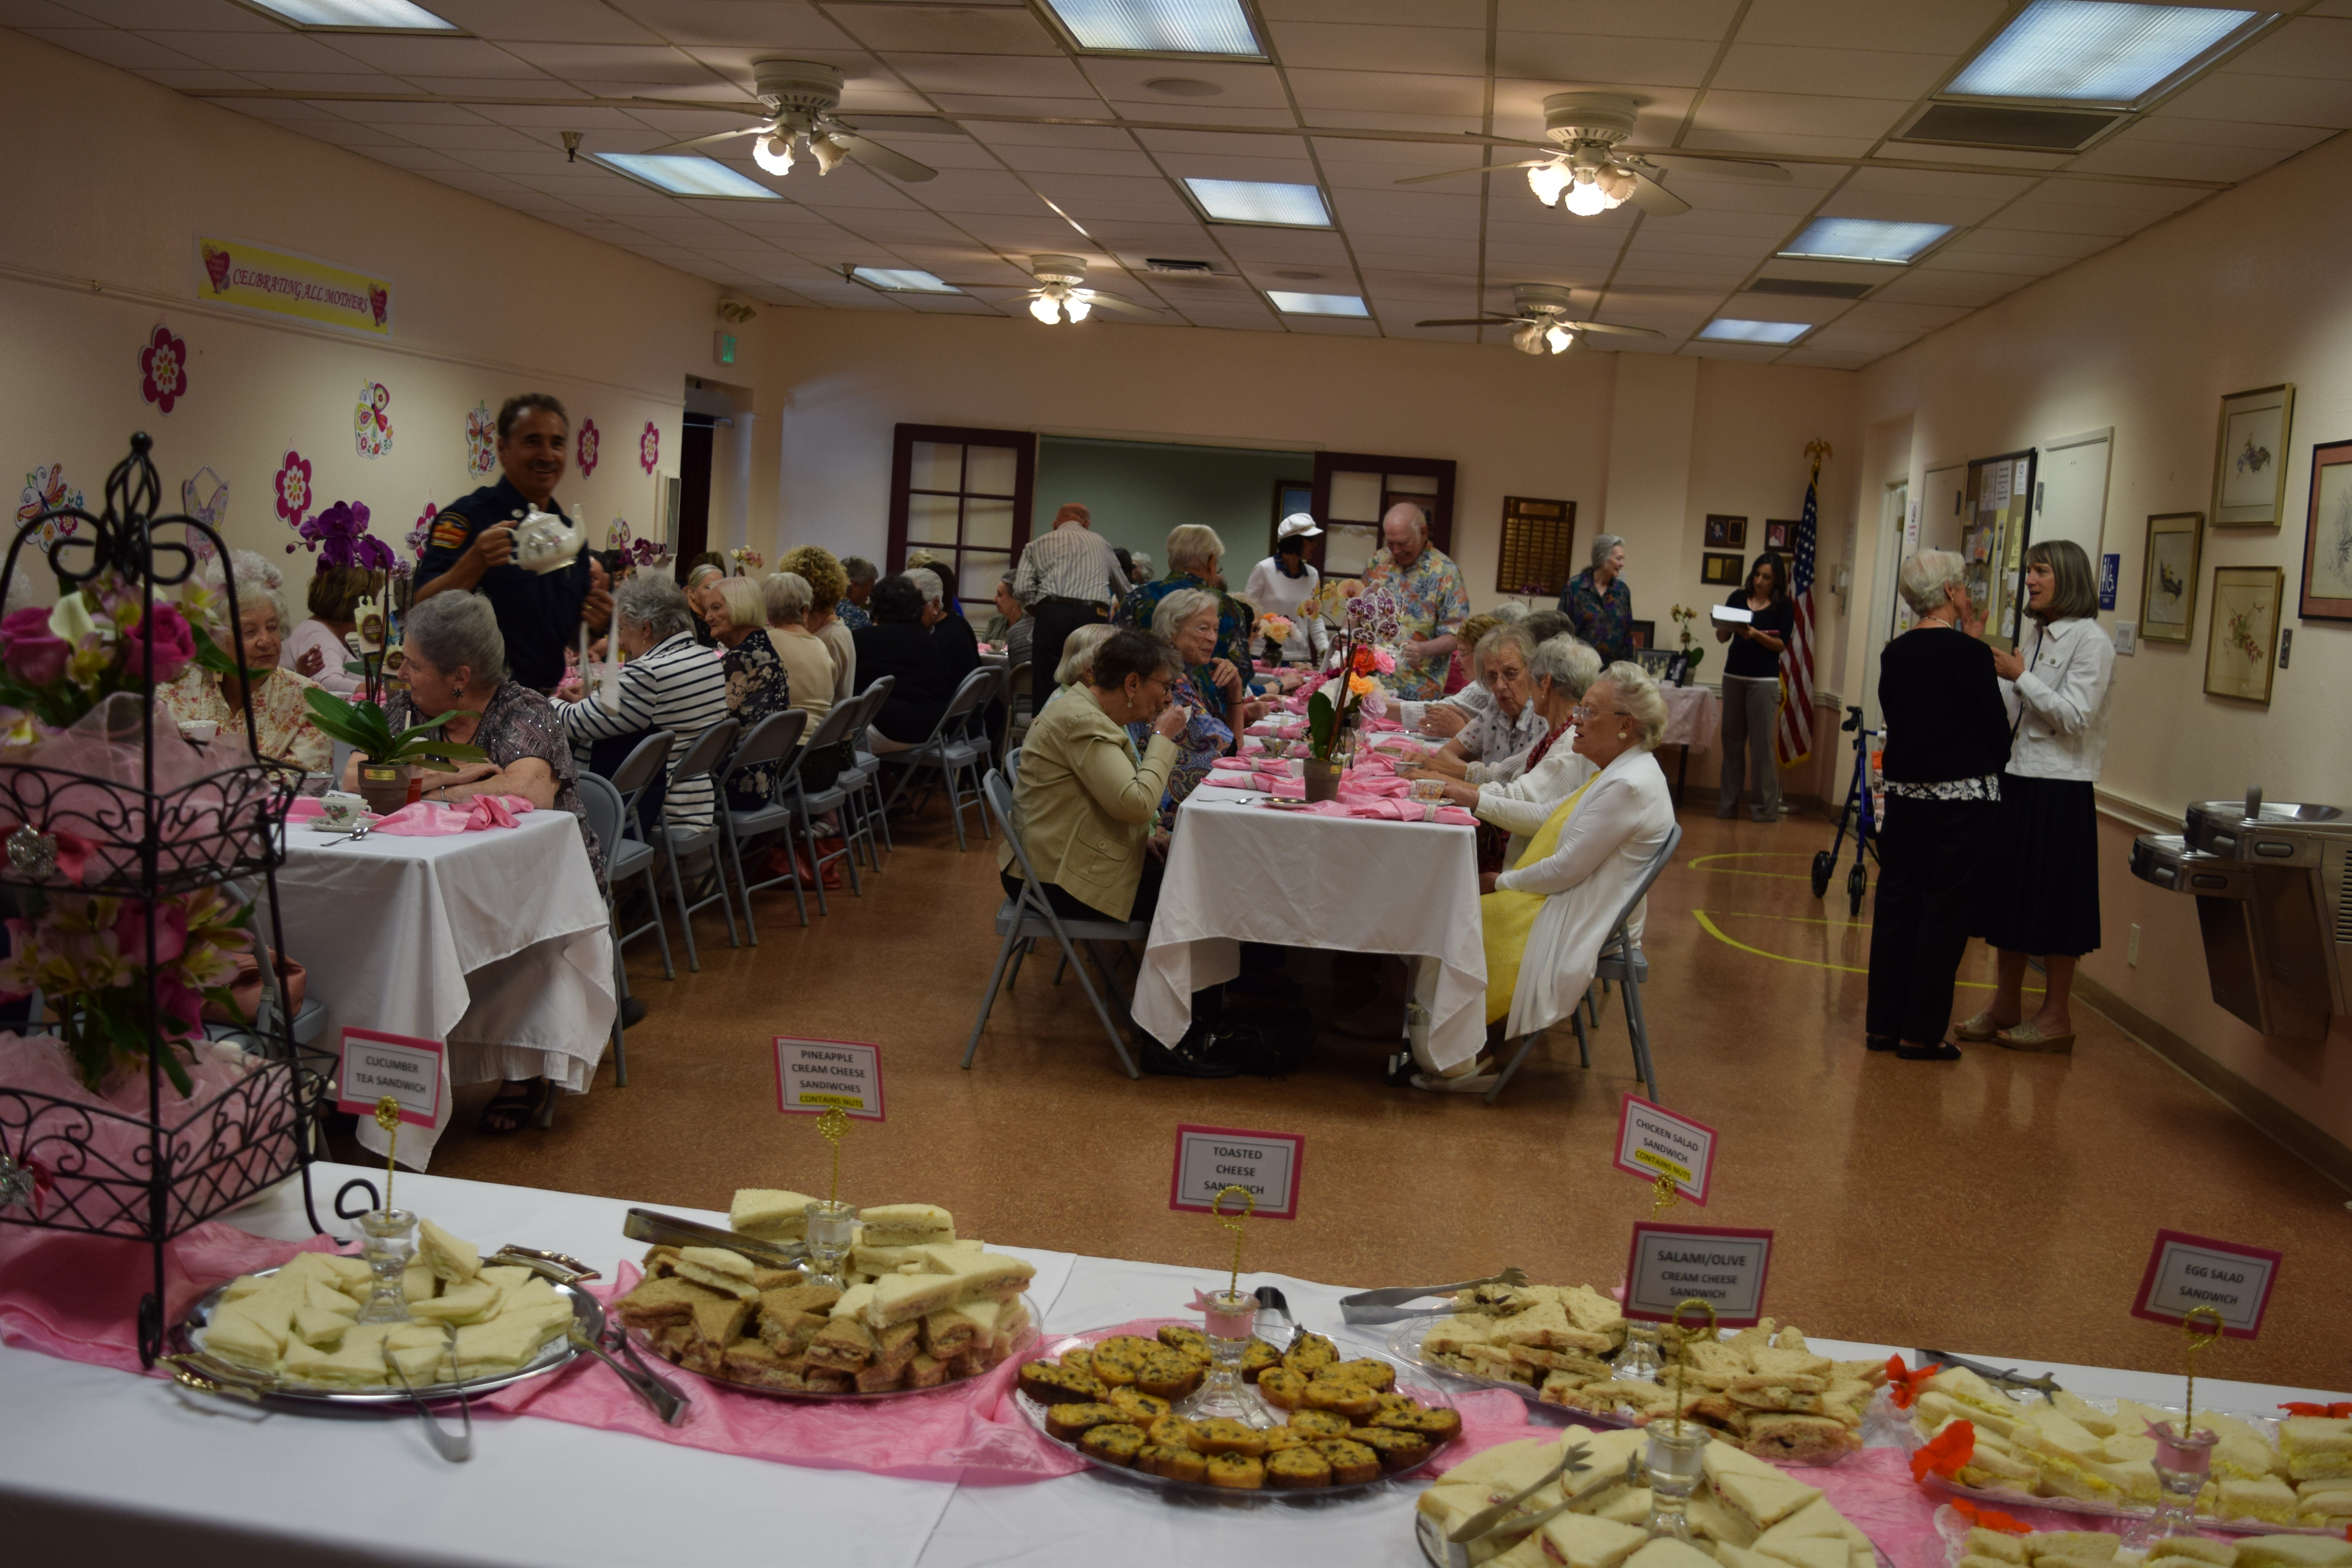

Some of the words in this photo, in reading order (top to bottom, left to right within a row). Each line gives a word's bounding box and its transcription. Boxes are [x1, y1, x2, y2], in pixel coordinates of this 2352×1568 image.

[233, 269, 302, 301] CELBRATING
[302, 284, 323, 301] ALL
[325, 289, 368, 313] MOTHERS
[801, 1050, 854, 1062] PINEAPPLE
[366, 1056, 419, 1073] CUCUMBER
[792, 1064, 828, 1074] CREAM
[831, 1067, 866, 1078] CHEESE
[356, 1073, 374, 1083] TEA
[376, 1076, 426, 1093] SANDWICH
[800, 1080, 861, 1093] SANDIWCHES
[800, 1095, 841, 1104] CONTAINS
[843, 1098, 863, 1107] NUTS
[1636, 1118, 1671, 1140] CHICKEN
[1672, 1134, 1699, 1152] SALAD
[1213, 1146, 1263, 1159] TOASTED
[1643, 1137, 1688, 1163] SANDWICH
[1216, 1164, 1256, 1176] CHEESE
[1635, 1150, 1671, 1171] CONTAINS
[1672, 1167, 1691, 1180] NUTS
[1657, 1250, 1746, 1266] SALAMI/OLIVE
[1661, 1271, 1699, 1282] CREAM
[1702, 1274, 1738, 1284] CHEESE
[2185, 1264, 2207, 1277] EGG
[2210, 1269, 2245, 1283] SALAD
[1670, 1286, 1726, 1298] SANDWICH
[2179, 1286, 2238, 1305] SANDWICH
